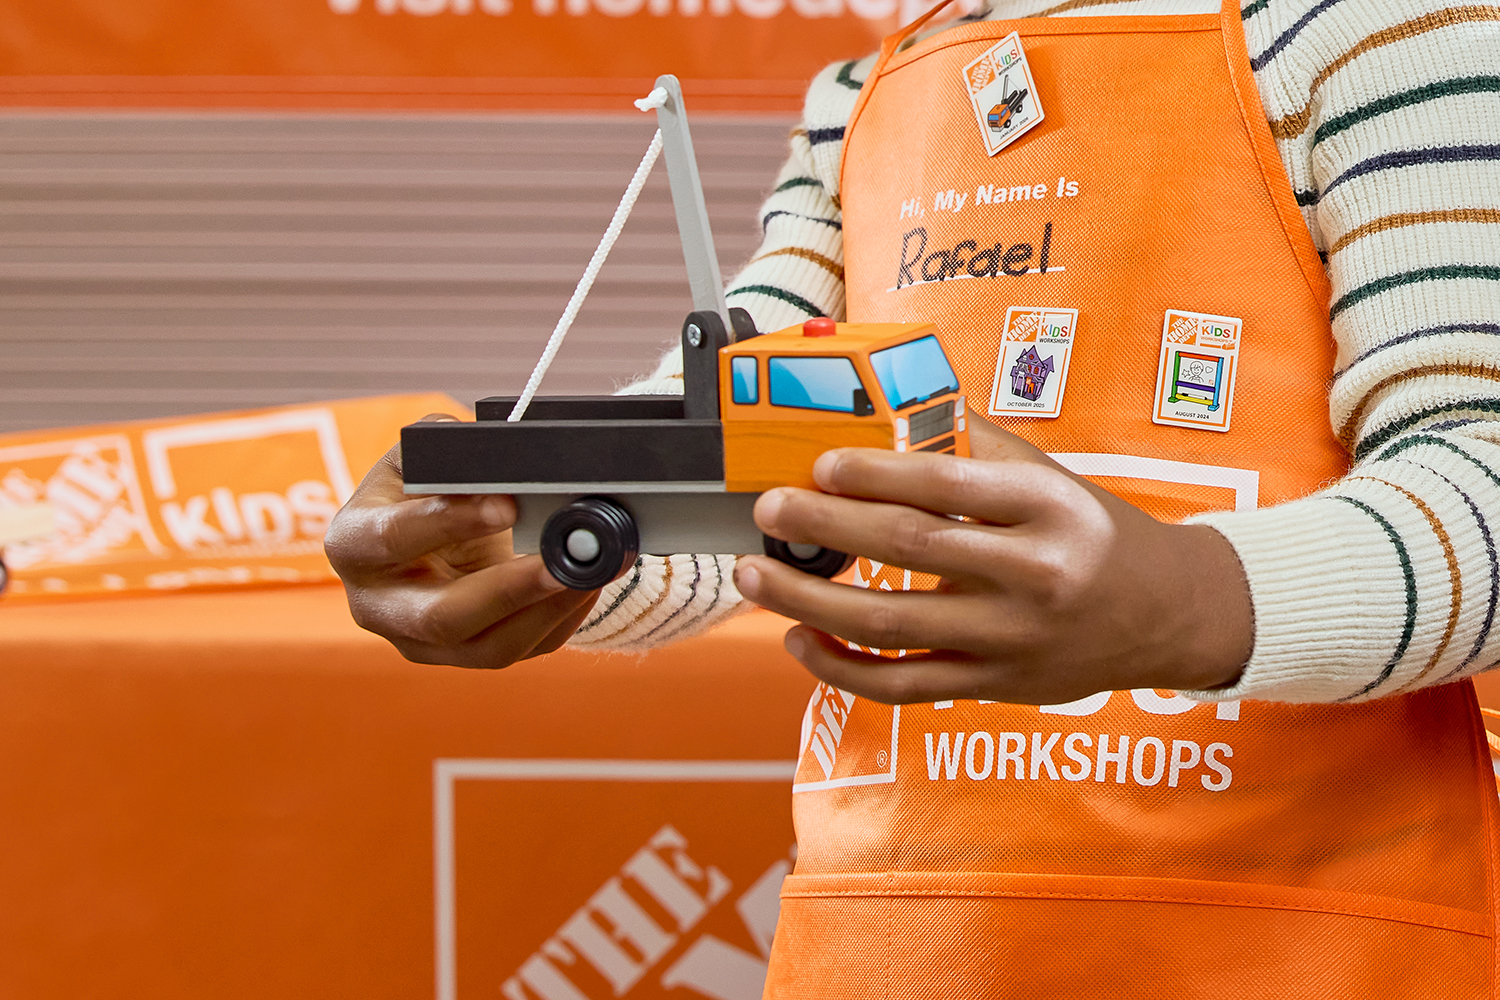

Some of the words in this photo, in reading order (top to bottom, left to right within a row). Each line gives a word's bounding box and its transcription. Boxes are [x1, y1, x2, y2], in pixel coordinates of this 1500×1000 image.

[994, 49, 1018, 70] KIDS
[998, 56, 1023, 76] WORKSHOPS
[1000, 124, 1019, 139] JANUARY
[900, 196, 925, 220] Hi,
[934, 189, 968, 213] My
[975, 183, 1047, 206] Name
[1056, 176, 1080, 198] Is
[896, 220, 1053, 290] Rafael
[1007, 310, 1041, 341] HOME
[1012, 314, 1025, 326] THE
[1167, 316, 1199, 343] HOME
[1171, 317, 1184, 329] THE
[1018, 323, 1038, 341] DEPOT
[1040, 324, 1069, 337] KIDS
[1178, 327, 1198, 344] DEPOT
[1201, 325, 1231, 338] KIDS
[160, 479, 339, 550] KIDS
[924, 731, 1235, 793] WORKSHOPS
[501, 822, 734, 1000] THE
